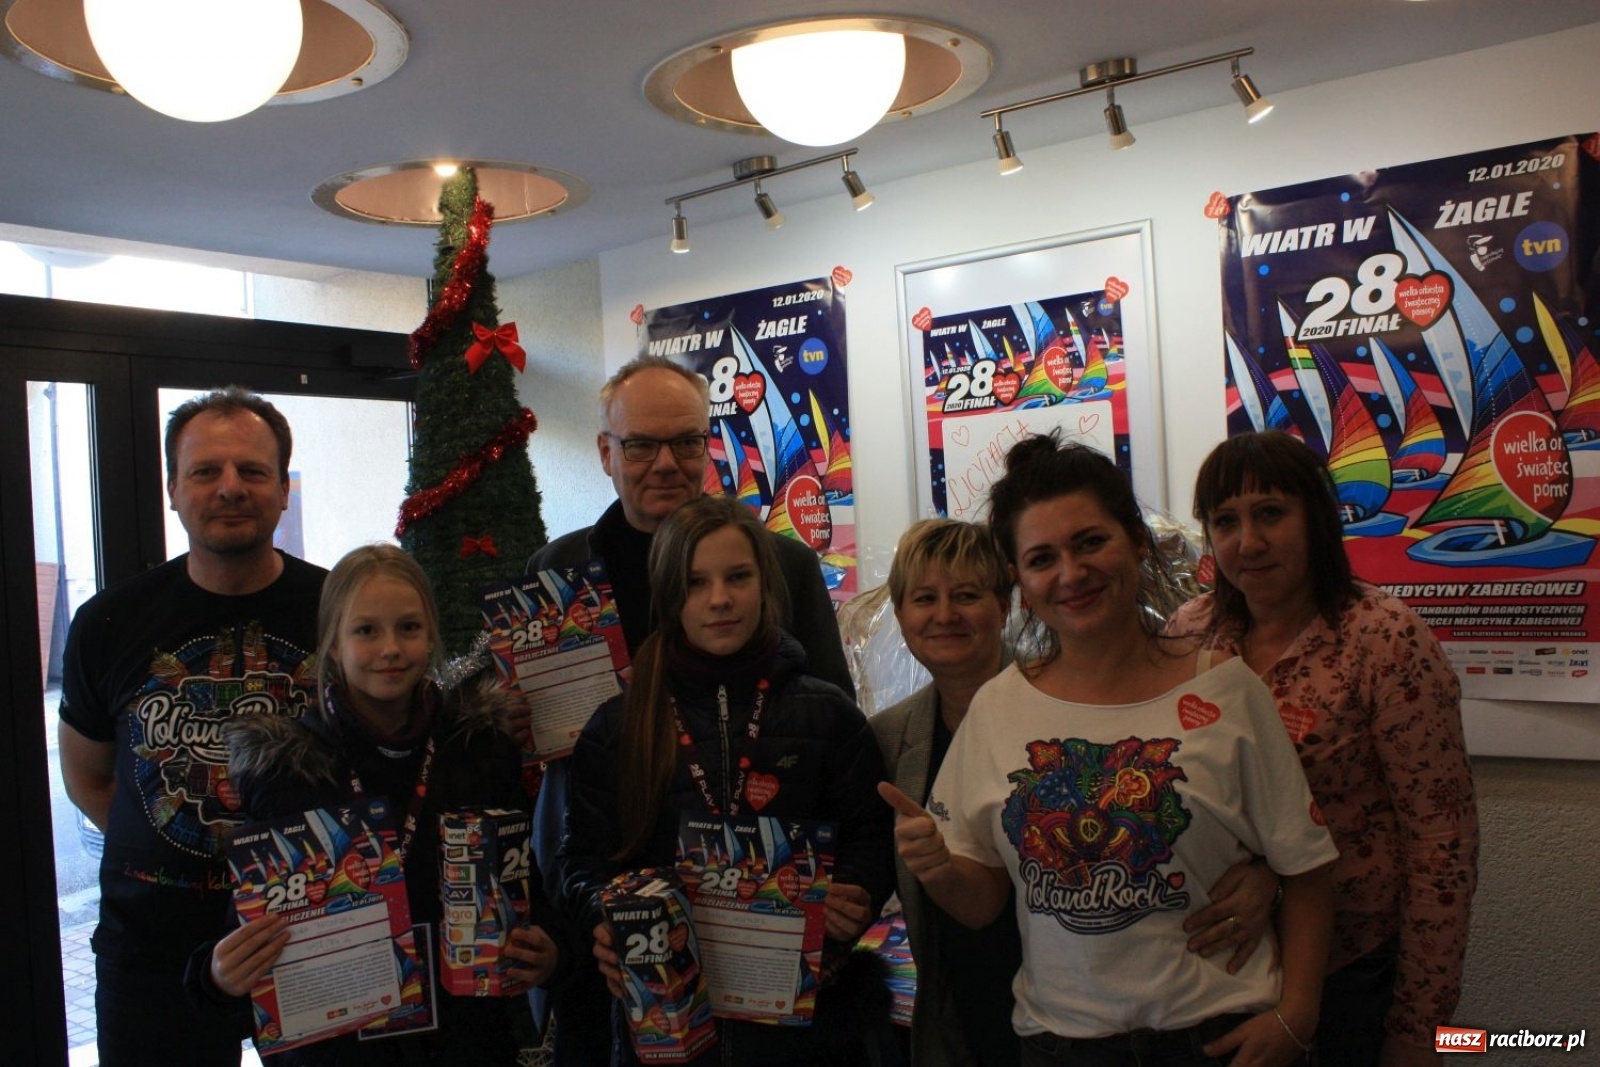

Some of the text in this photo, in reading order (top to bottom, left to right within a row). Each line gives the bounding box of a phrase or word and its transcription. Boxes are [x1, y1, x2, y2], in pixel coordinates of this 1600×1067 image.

[1468, 153, 1565, 183] 12.01.2020
[1434, 191, 1533, 229] ŻAGLE
[1241, 215, 1376, 257] WIATR W
[1521, 239, 1561, 256] tvn
[772, 290, 824, 308] 12.01.2020
[1298, 253, 1407, 340] 28
[1400, 283, 1444, 298] wielka orkiestra
[1405, 296, 1441, 309] świątecznej
[1412, 306, 1435, 319] pomocy
[755, 315, 808, 340] ŻAGLE
[930, 324, 968, 337] WIATR W
[981, 318, 1007, 329] ŻAGLE
[1303, 313, 1402, 338] 2020 FINAŁ
[648, 329, 724, 357] WIATR W
[803, 350, 824, 364] tvn
[943, 359, 996, 412] 28
[709, 402, 738, 417] INAŁ
[963, 396, 997, 410] FINAŁ
[1504, 431, 1547, 455] wielka
[793, 490, 817, 507] wielka
[1380, 582, 1586, 597] MEDYCYNY ZABIEGOWEJ
[1482, 605, 1585, 615] DIAGNOSTYCZNYCH
[1455, 617, 1512, 627] MEDYCYNIE
[1512, 617, 1582, 627] ZABIEGOWEJ
[512, 620, 544, 653] 28
[748, 692, 765, 740] 28 PLAY
[690, 763, 716, 806] 28 PLAY
[734, 770, 746, 800] PLAY
[405, 814, 417, 831] 28
[697, 868, 742, 893] 28
[265, 873, 308, 915] 28
[450, 890, 469, 899] AY
[285, 908, 326, 922] LICZENIE
[613, 910, 650, 922] WIATR
[625, 920, 670, 965] 28
